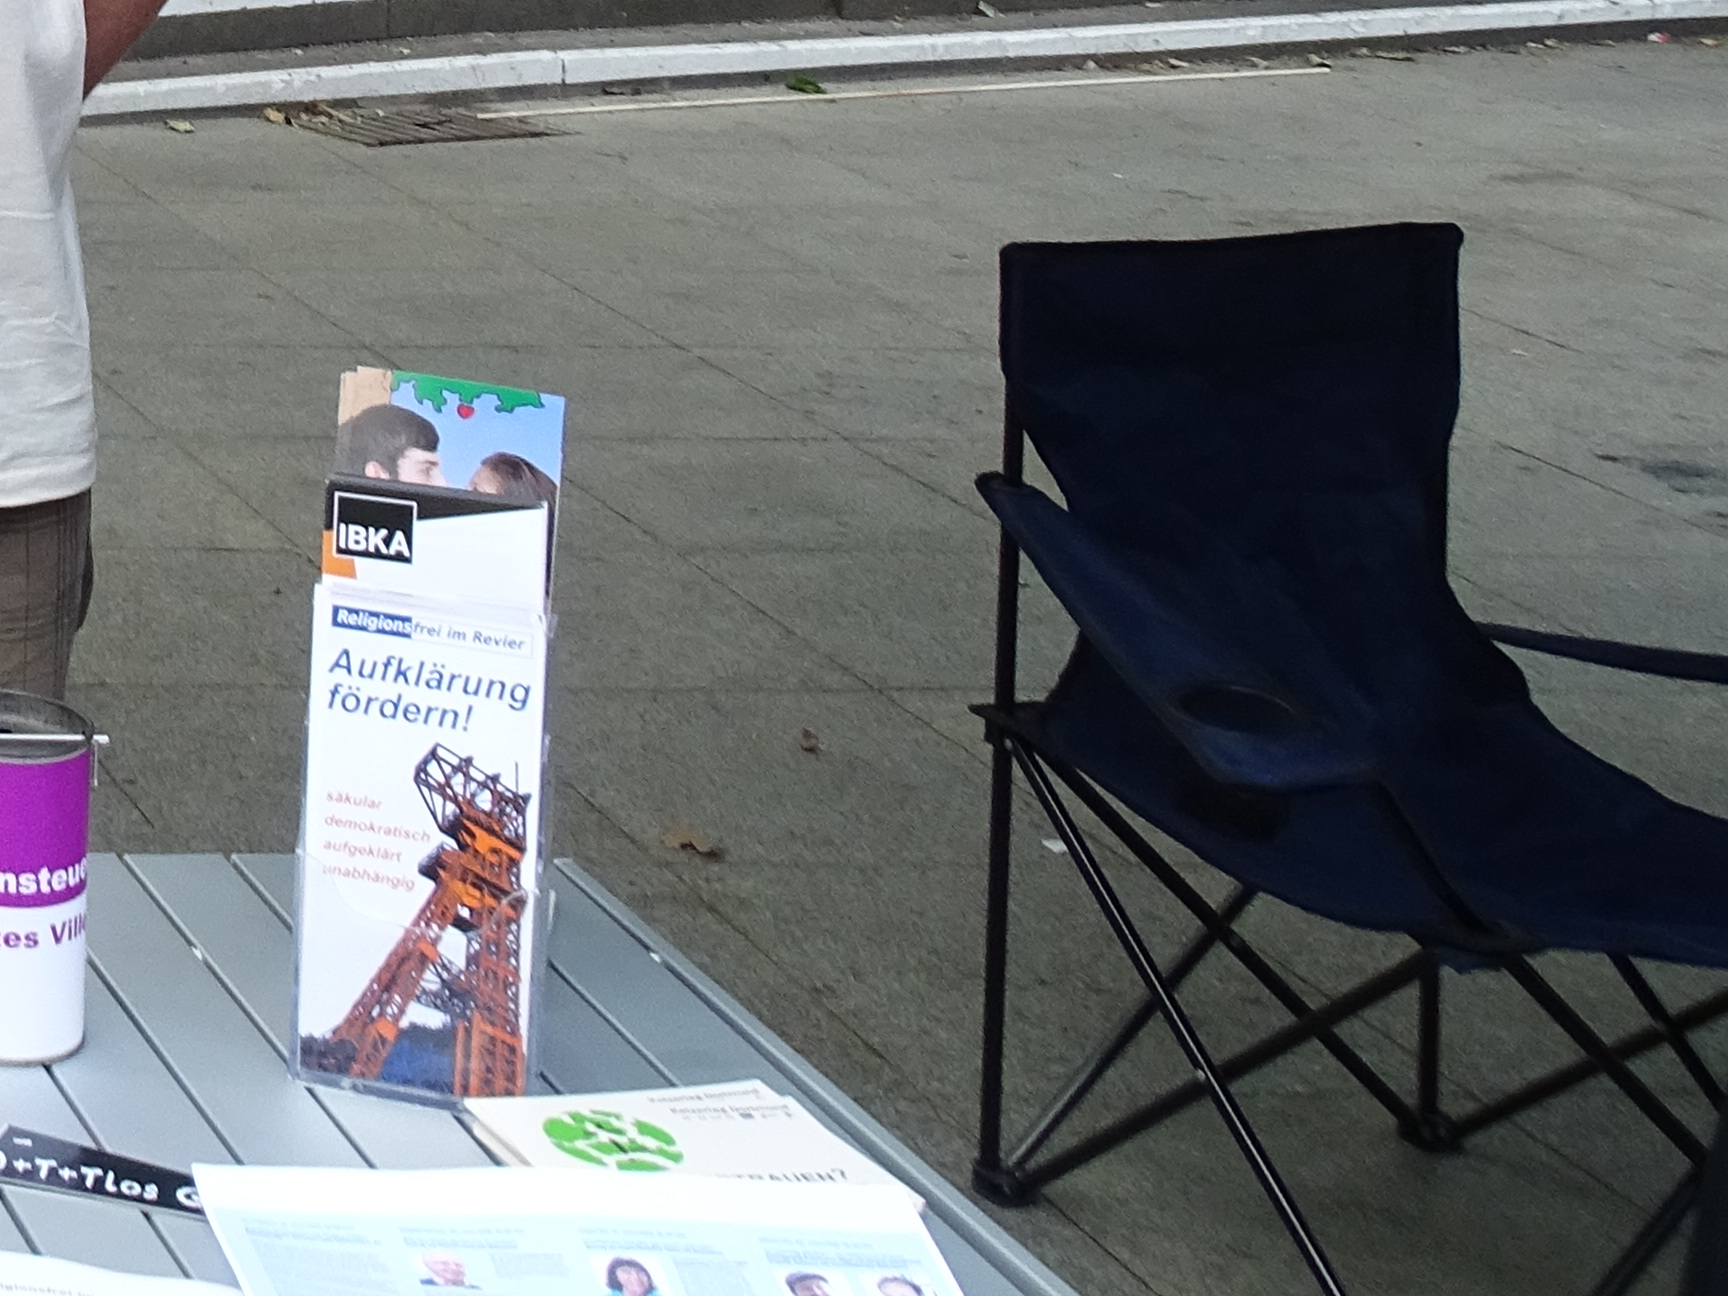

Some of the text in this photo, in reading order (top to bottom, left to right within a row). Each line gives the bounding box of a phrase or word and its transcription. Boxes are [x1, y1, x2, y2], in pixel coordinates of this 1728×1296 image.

[338, 523, 411, 558] IBKA
[447, 626, 467, 641] im
[472, 630, 525, 651] Revier
[328, 648, 532, 712] Aufklärung
[328, 682, 474, 733] fördern!
[324, 814, 431, 842] demokratisch
